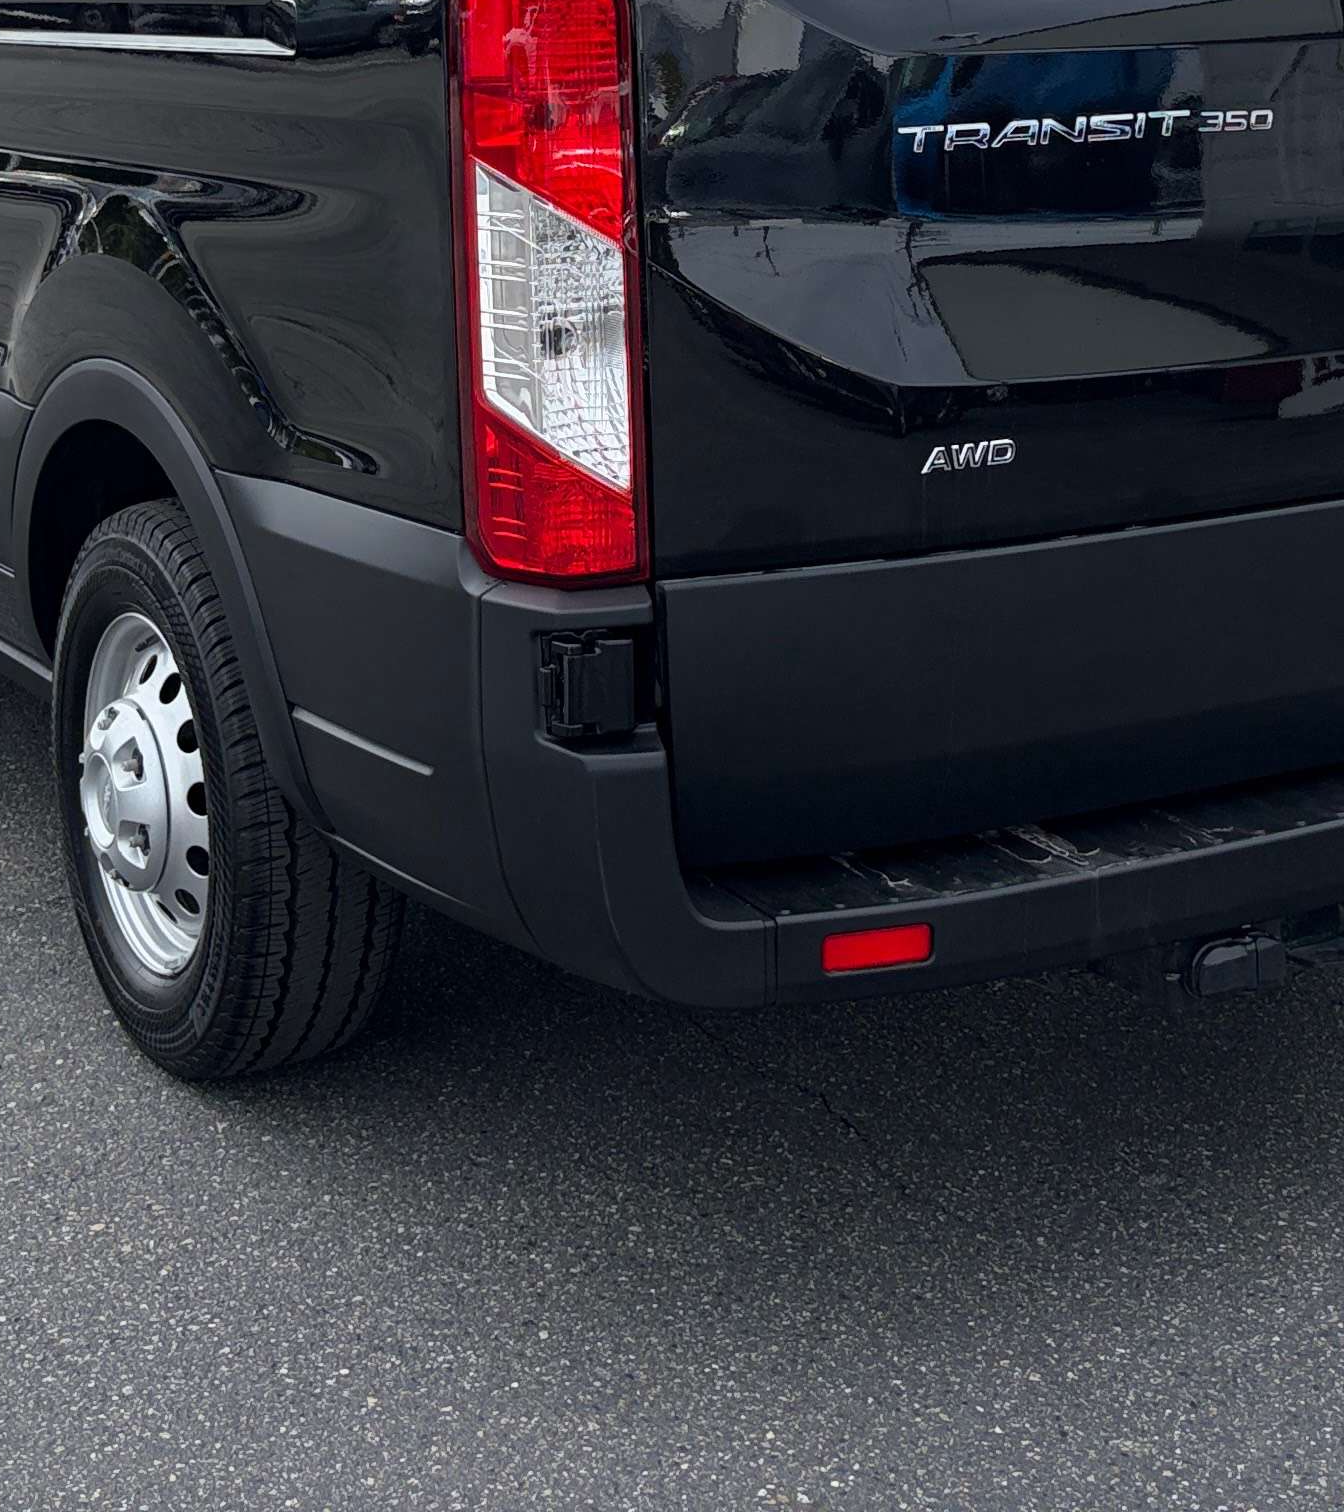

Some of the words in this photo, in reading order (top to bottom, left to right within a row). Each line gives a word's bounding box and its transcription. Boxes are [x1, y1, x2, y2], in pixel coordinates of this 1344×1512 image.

[897, 109, 1191, 153] TRANSIT
[1197, 109, 1274, 132] 350
[920, 438, 1017, 475] AWD
